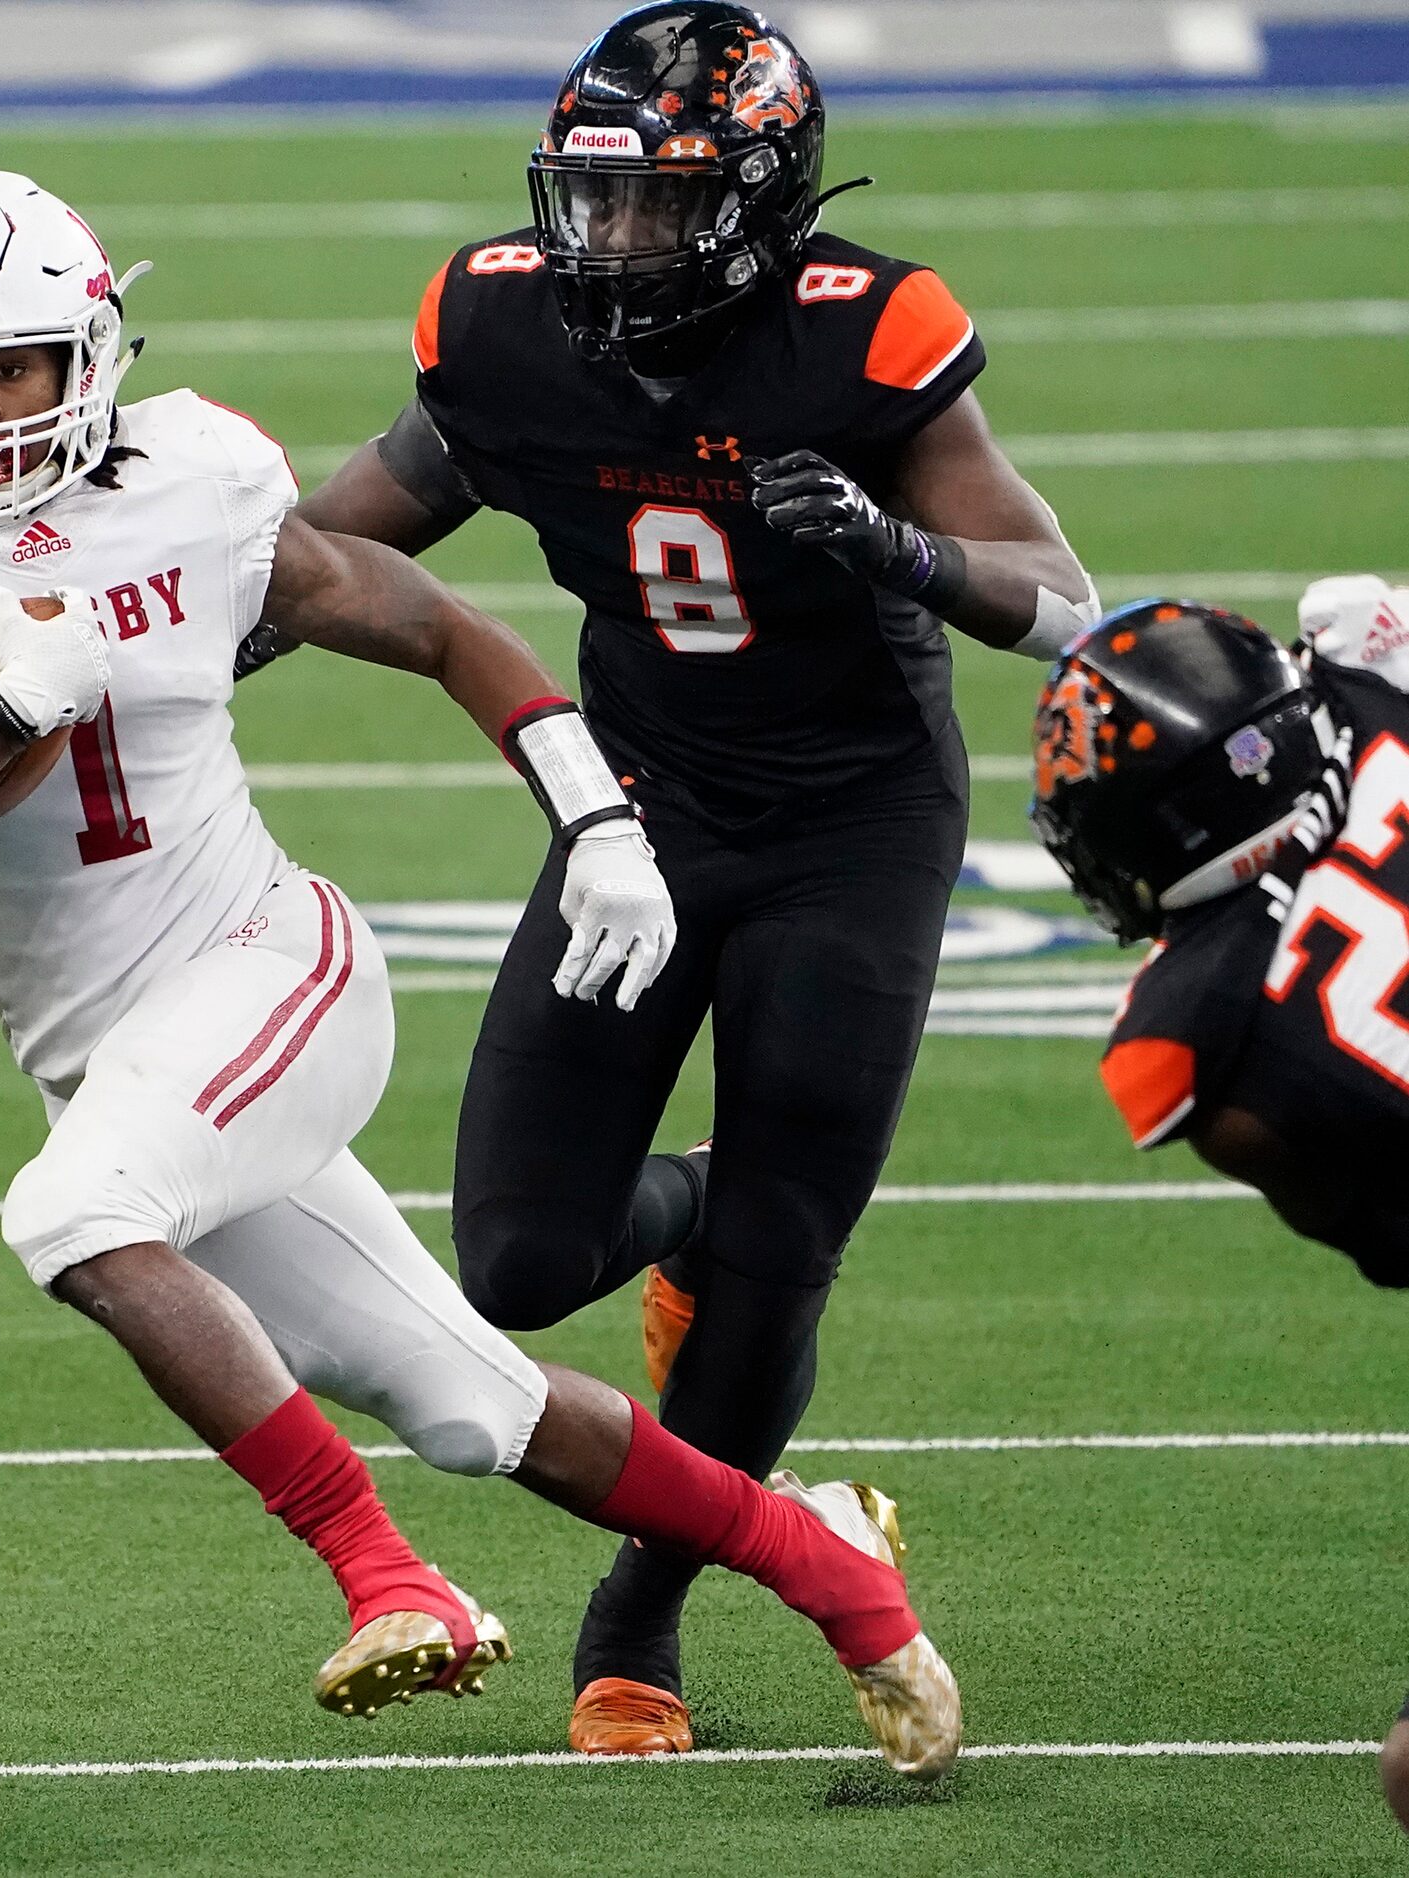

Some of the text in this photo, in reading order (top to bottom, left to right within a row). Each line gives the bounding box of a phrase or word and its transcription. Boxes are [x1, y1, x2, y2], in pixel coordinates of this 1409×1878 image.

[571, 132, 629, 149] Riddell
[465, 244, 546, 276] 8
[794, 262, 877, 306] 8
[596, 464, 746, 502] BEARCATS
[11, 536, 72, 564] adidas
[626, 502, 757, 655] 8
[70, 689, 154, 867] 1
